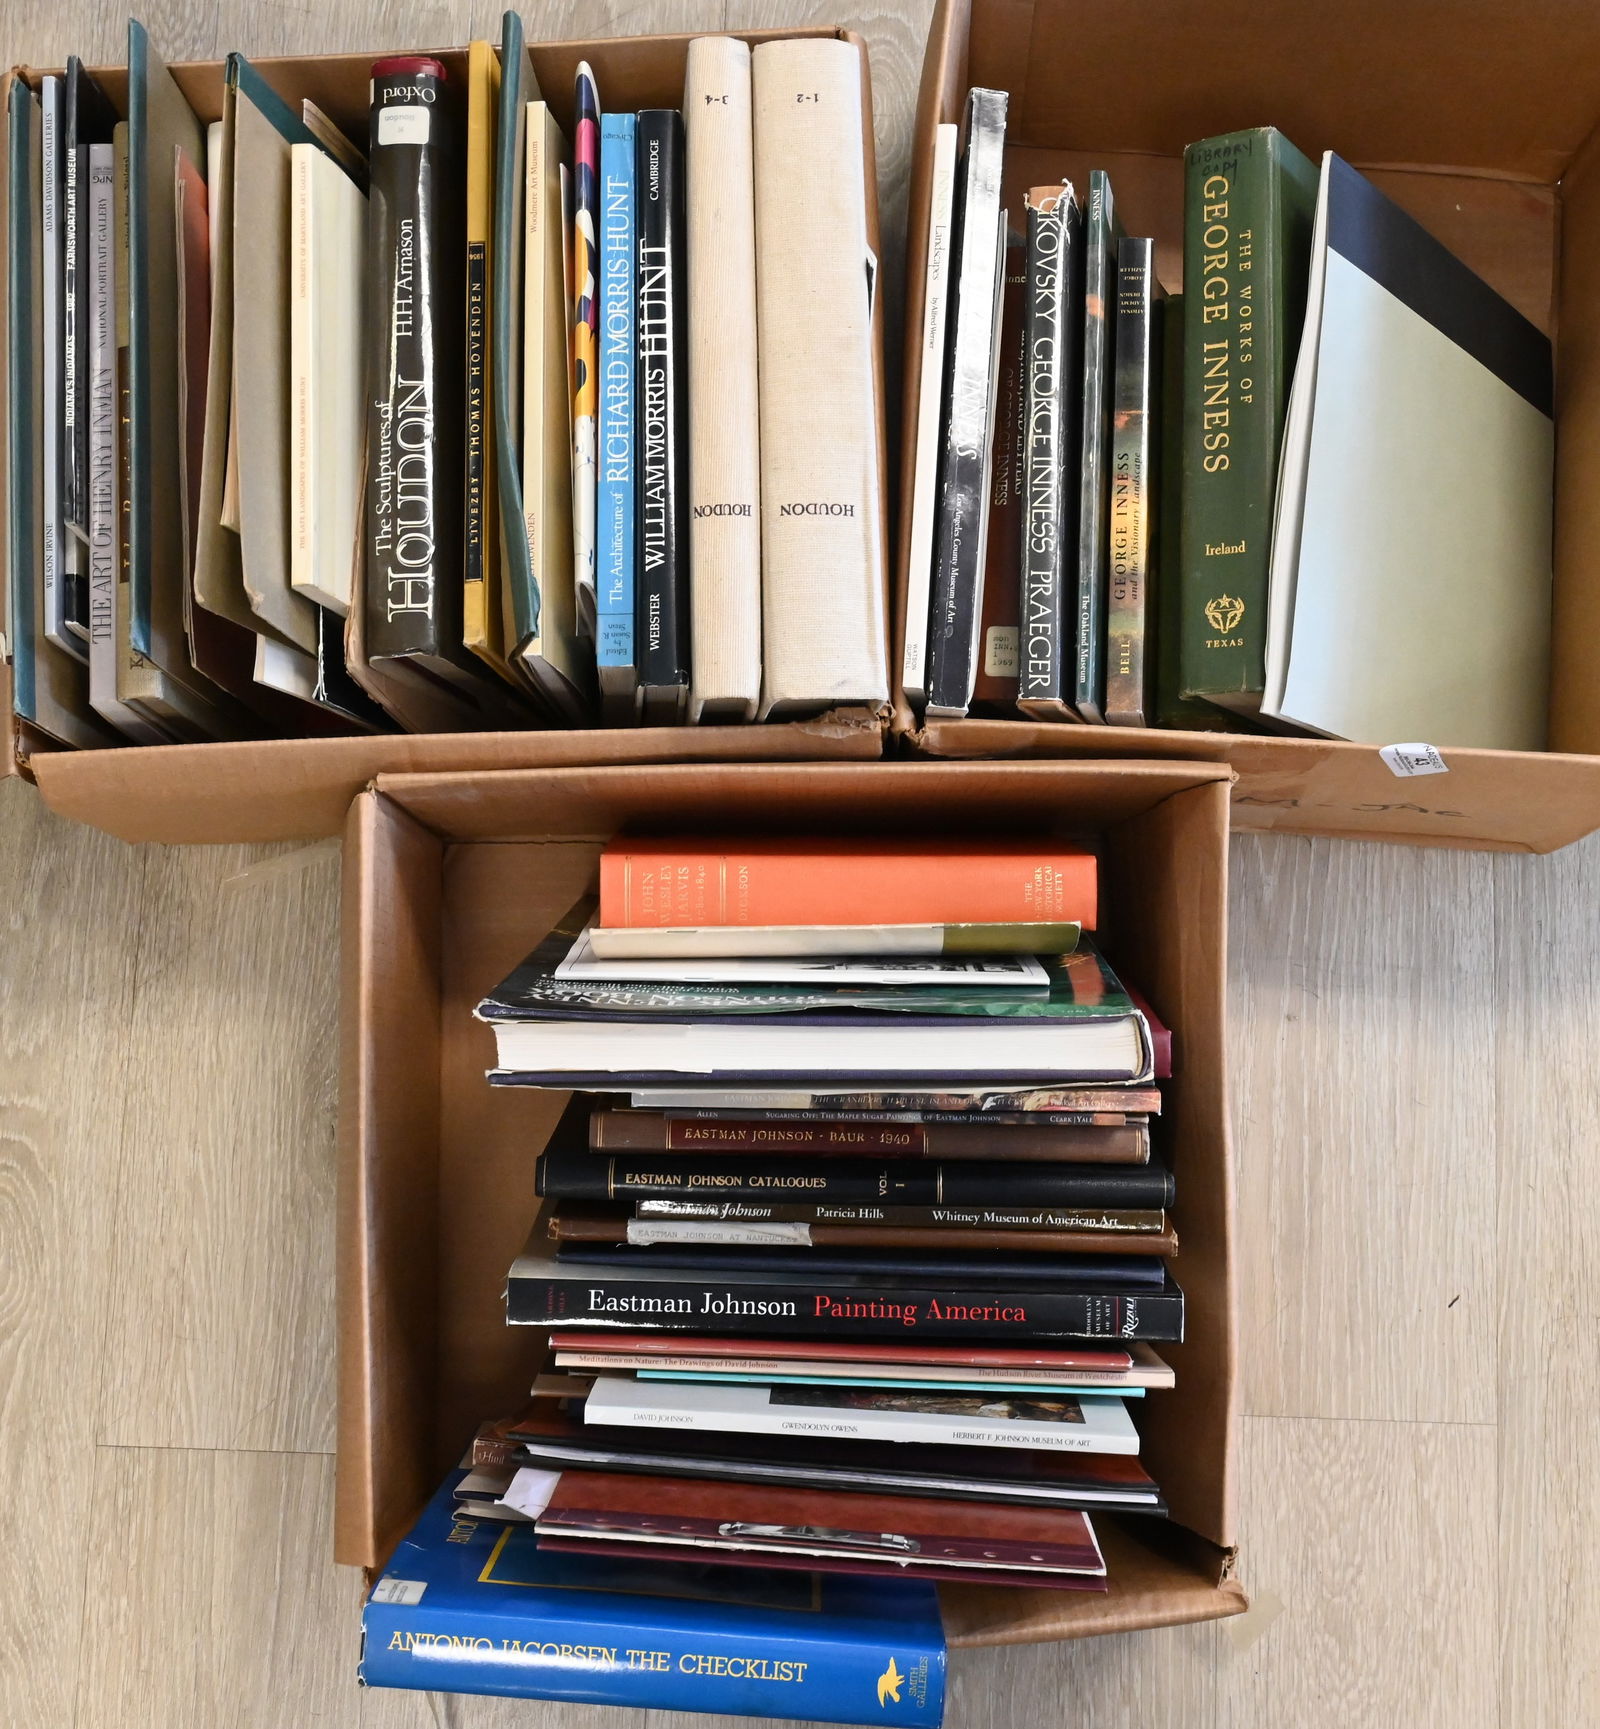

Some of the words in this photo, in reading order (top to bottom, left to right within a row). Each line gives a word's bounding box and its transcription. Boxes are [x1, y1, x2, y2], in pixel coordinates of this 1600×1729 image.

[383, 86, 436, 104] Oxford
[705, 95, 729, 106] 3-4
[796, 93, 819, 103] 1-2
[44, 112, 53, 158] GALLERIES
[67, 148, 77, 187] MUSEUM
[530, 140, 538, 175] Museum
[649, 139, 660, 201] CAMBRIDGE
[44, 159, 53, 201] DAVIDSON
[67, 188, 76, 206] ART
[93, 176, 113, 184] NPG
[530, 176, 538, 190] Art
[44, 202, 53, 233] ADAMS
[97, 197, 109, 243] GALLERY
[530, 192, 538, 234] Woodmere
[606, 175, 629, 251] HUNT
[1092, 189, 1101, 221] INNESS
[66, 206, 76, 270] FARNSWORTH
[396, 218, 413, 290] Arnason
[928, 225, 946, 281] Landscapes
[1202, 174, 1231, 324] GEORGE
[1238, 228, 1251, 271] THE
[97, 245, 109, 295] PORTRAIT
[395, 295, 413, 337] H.H.
[606, 258, 629, 354] MORRIS
[639, 238, 668, 360] HUNT
[930, 296, 939, 304] by
[930, 305, 939, 326] Alfred
[97, 296, 109, 349] NATIONAL
[470, 282, 481, 375] HOVENDEN
[928, 327, 937, 349] Werner
[1239, 284, 1252, 362] WORKS
[91, 367, 112, 436] INMAN
[1032, 337, 1056, 448] GEORGE
[1203, 339, 1230, 473] INNESS
[1239, 378, 1253, 403] OF
[374, 400, 391, 422] of
[470, 387, 480, 457] THOMAS
[606, 355, 629, 482] RICHARD
[645, 368, 665, 459] MORRIS
[91, 435, 112, 516] HENRY
[375, 421, 397, 515] Sculptures
[994, 454, 1011, 506] INNESS
[1115, 451, 1129, 516] INNESS
[1131, 451, 1142, 505] Landscape
[387, 374, 435, 623] HOUDON
[609, 490, 623, 506] of
[692, 503, 753, 519] HOUDON
[779, 503, 855, 517] HOUDON
[956, 493, 965, 507] Los
[1032, 456, 1055, 554] INNESS
[91, 521, 112, 548] OF
[645, 464, 665, 572] WILLIAM
[953, 507, 963, 537] Angeles
[1130, 505, 1142, 557] Visionary
[45, 522, 54, 552] IRVINE
[375, 518, 393, 556] The
[609, 506, 624, 577] Architecture
[951, 538, 962, 567] County
[1204, 540, 1246, 556] Ireland
[45, 553, 54, 589] WILSON
[91, 551, 112, 594] ART
[1113, 525, 1128, 601] GEORGE
[1130, 559, 1139, 576] the
[609, 578, 623, 605] The
[949, 567, 960, 599] Museum
[1129, 580, 1138, 600] and
[947, 610, 956, 624] Art
[948, 600, 957, 609] of
[1082, 594, 1091, 610] The
[91, 598, 112, 645] THE
[649, 593, 660, 651] WEBSTER
[1028, 570, 1053, 690] PRAEGER
[1081, 612, 1090, 646] Oakland
[1119, 641, 1130, 675] BELL
[1205, 637, 1244, 648] TEXAS
[1080, 648, 1089, 683] Museum
[642, 872, 656, 916] JOHN
[677, 866, 692, 919] JARVIS
[739, 865, 750, 921] DICKSON
[1024, 882, 1033, 903] THE
[696, 1110, 719, 1118] ALLEN
[684, 1128, 748, 1140] EASTMAN
[751, 1129, 815, 1142] JOHNSON
[829, 1131, 866, 1143] BAUR
[878, 1132, 910, 1146] 1940
[625, 1173, 682, 1186] EASTMAN
[687, 1174, 743, 1188] JOHNSON
[748, 1175, 828, 1189] CATALOGUES
[719, 1202, 773, 1219] Johnson
[816, 1206, 857, 1219] Patricia
[858, 1207, 884, 1220] Hills
[932, 1209, 982, 1224] Whitney
[983, 1210, 1031, 1224] Museum
[1031, 1211, 1044, 1224] of
[1045, 1213, 1097, 1227] American
[1098, 1215, 1119, 1228] Art
[637, 1228, 679, 1239] EASTMAN
[682, 1230, 725, 1241] JOHNSON
[729, 1231, 741, 1241] AT
[587, 1288, 694, 1314] Eastman
[699, 1291, 798, 1317] Johnson
[813, 1294, 919, 1326] Painting
[925, 1297, 1028, 1323] America
[578, 1354, 622, 1364] Meditations
[623, 1357, 634, 1365] on
[634, 1356, 663, 1366] Nature:
[663, 1357, 678, 1366] The
[678, 1358, 715, 1370] Drawings
[715, 1359, 724, 1369] of
[724, 1359, 747, 1369] David
[748, 1360, 779, 1371] Johnson
[977, 1369, 990, 1378] The
[991, 1369, 1018, 1378] Hudson
[1018, 1370, 1040, 1379] River
[1040, 1371, 1075, 1380] Museum
[633, 1413, 657, 1422] DAVID
[656, 1414, 694, 1424] JOHNSON
[781, 1421, 830, 1433] GWENDOLYN
[831, 1424, 859, 1434] OWENS
[951, 1431, 985, 1442] HERBERT
[993, 1432, 1030, 1444] JOHNSON
[1030, 1435, 1062, 1446] MUSEUM
[1063, 1436, 1075, 1447] OF
[1076, 1437, 1091, 1448] ART
[386, 1630, 496, 1656] ANTONIO
[501, 1638, 618, 1667] JACOBSEN
[625, 1649, 672, 1674] THE
[678, 1653, 808, 1684] CHECKLIST
[909, 1666, 918, 1696] SMITH
[917, 1655, 930, 1709] GALLERIES
